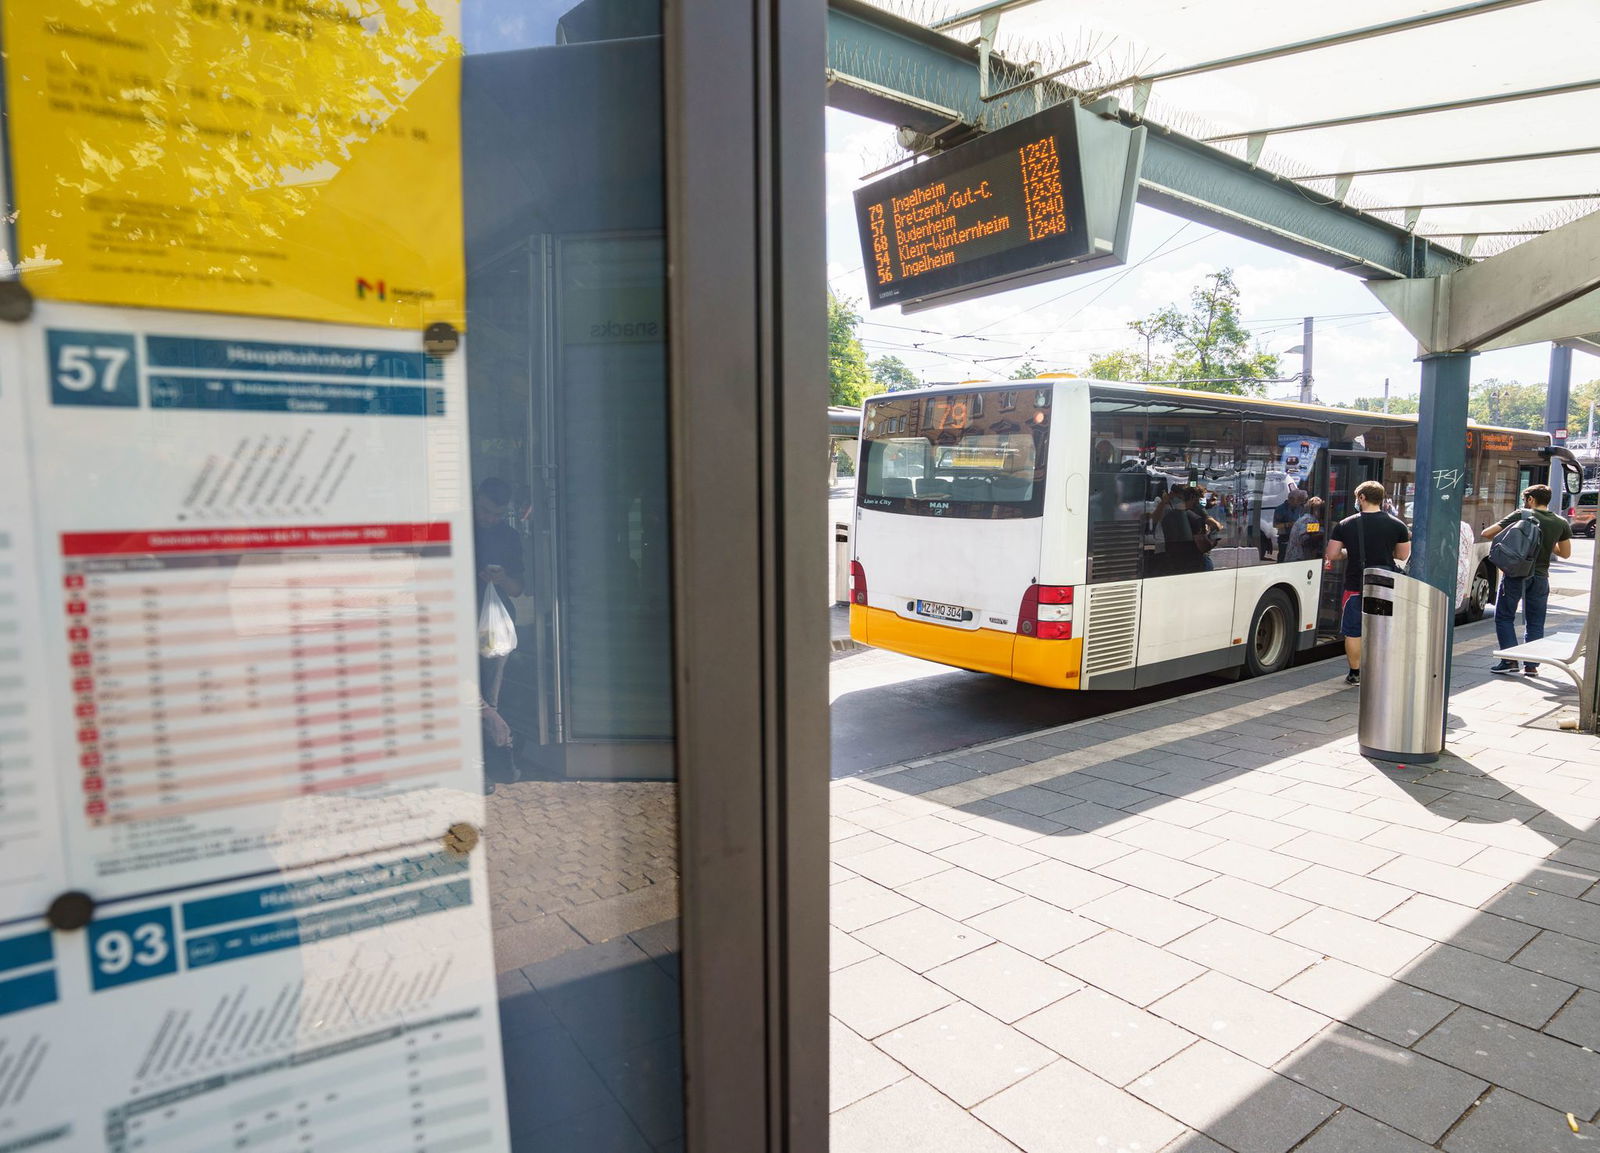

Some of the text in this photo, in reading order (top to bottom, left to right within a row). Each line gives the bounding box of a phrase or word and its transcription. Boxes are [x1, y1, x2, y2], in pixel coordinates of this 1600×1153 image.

[868, 136, 1056, 222] 79 Ingelheim 12:21
[871, 219, 885, 237] 57
[1021, 155, 1060, 185] 12:22
[873, 175, 1062, 253] 68 Budenheim 12:36
[875, 194, 1064, 269] 54 Klein-Winternheim 12:40
[877, 213, 1067, 284] 56 Ingelheim 12:48
[58, 344, 130, 392] 57
[935, 402, 967, 430] 79
[879, 498, 893, 506] City
[929, 501, 949, 509] MAN
[935, 604, 946, 616] MQ
[946, 606, 961, 618] 304
[96, 921, 169, 975] 93
